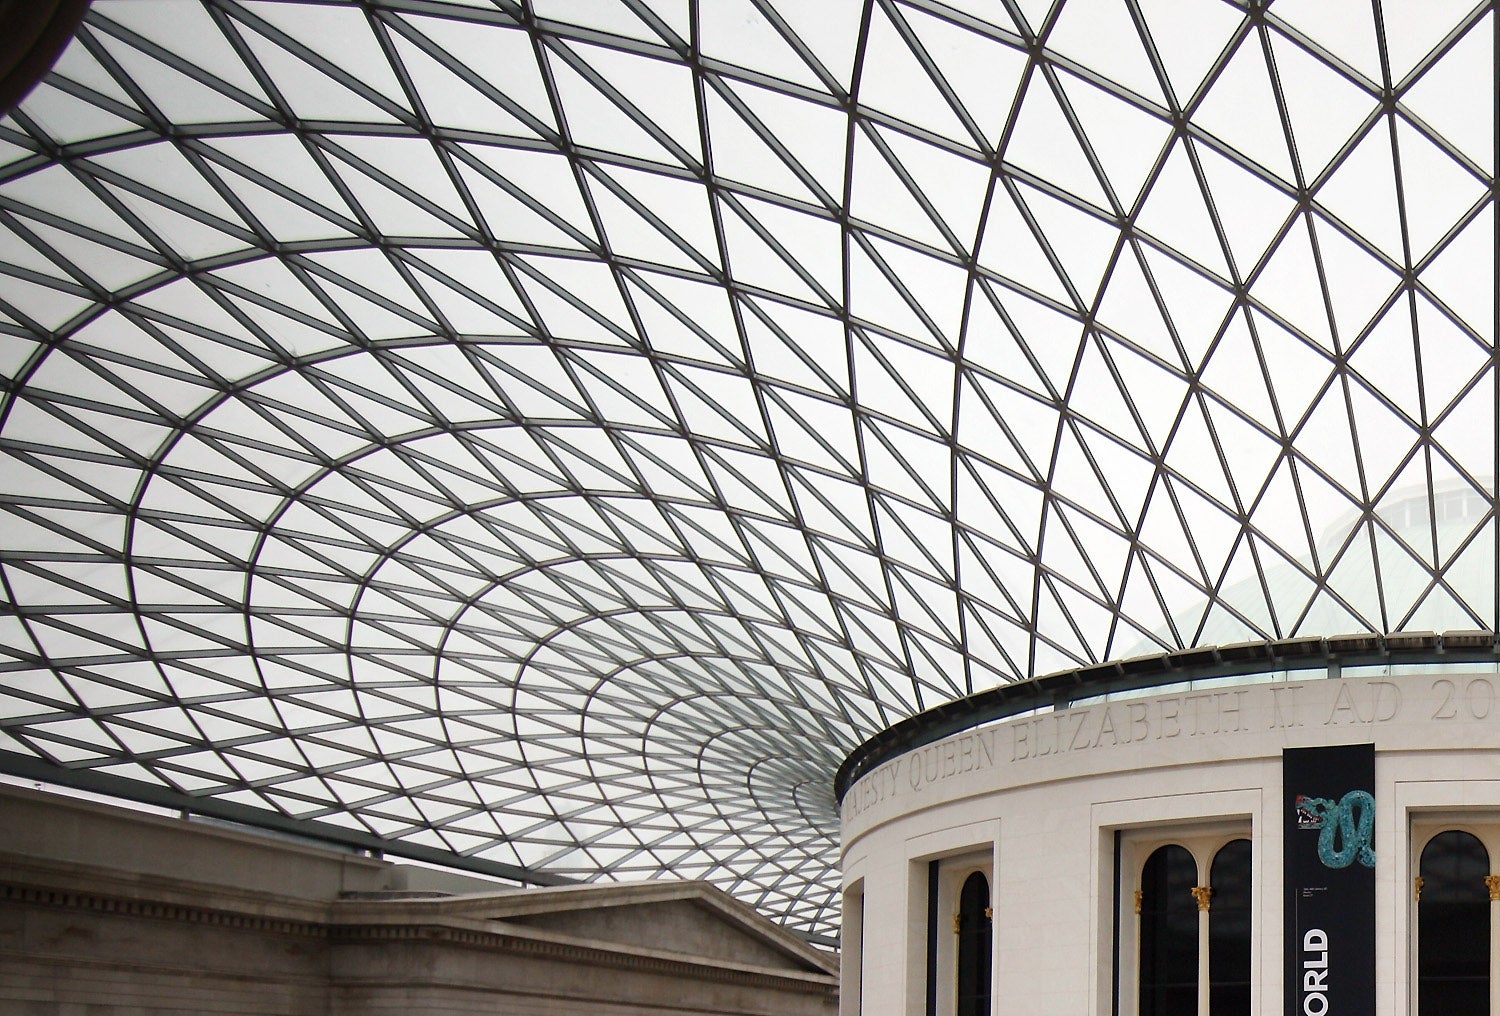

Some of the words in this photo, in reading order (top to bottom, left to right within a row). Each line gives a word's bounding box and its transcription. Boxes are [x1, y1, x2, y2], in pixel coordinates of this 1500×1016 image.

[909, 730, 998, 793] QUEEN
[1011, 690, 1249, 762] ELIZABETH
[1269, 686, 1304, 729] II
[1323, 681, 1402, 725] AD
